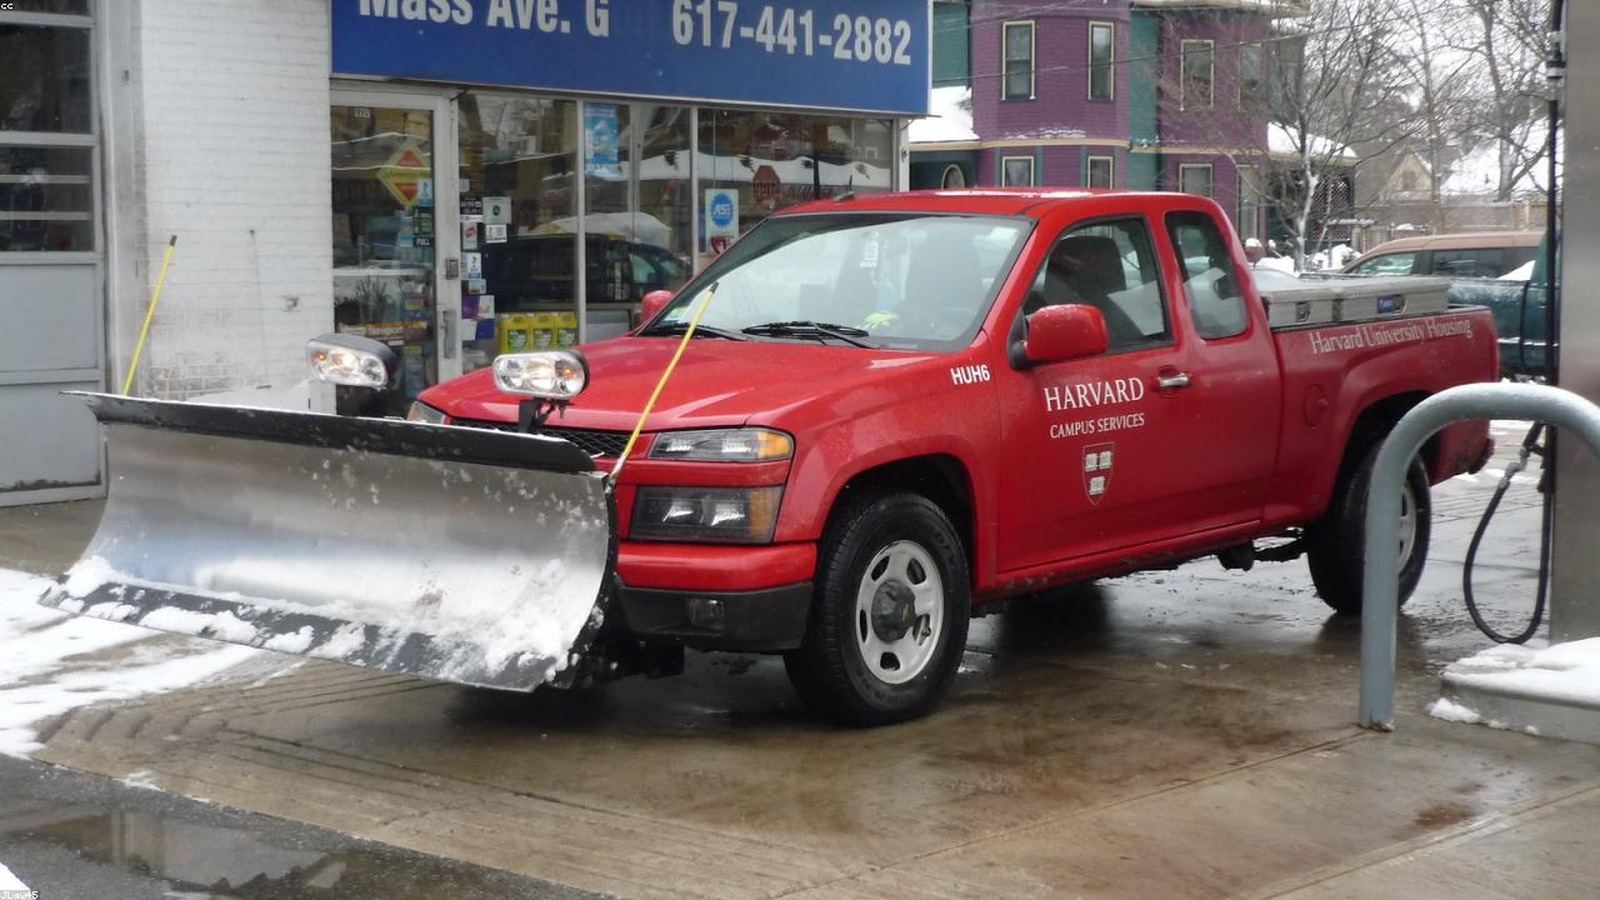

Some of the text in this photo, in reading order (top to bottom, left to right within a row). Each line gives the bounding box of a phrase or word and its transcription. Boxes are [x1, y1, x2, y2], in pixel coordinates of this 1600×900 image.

[486, 0, 571, 34] Ave.
[585, 0, 610, 38] G
[672, 0, 911, 65] 617-441-2882
[1310, 317, 1473, 354] Harvard University Housing
[950, 364, 990, 385] HUH6
[1044, 377, 1144, 411] HARVARD
[1049, 413, 1145, 439] CAMPUS SERVICES
